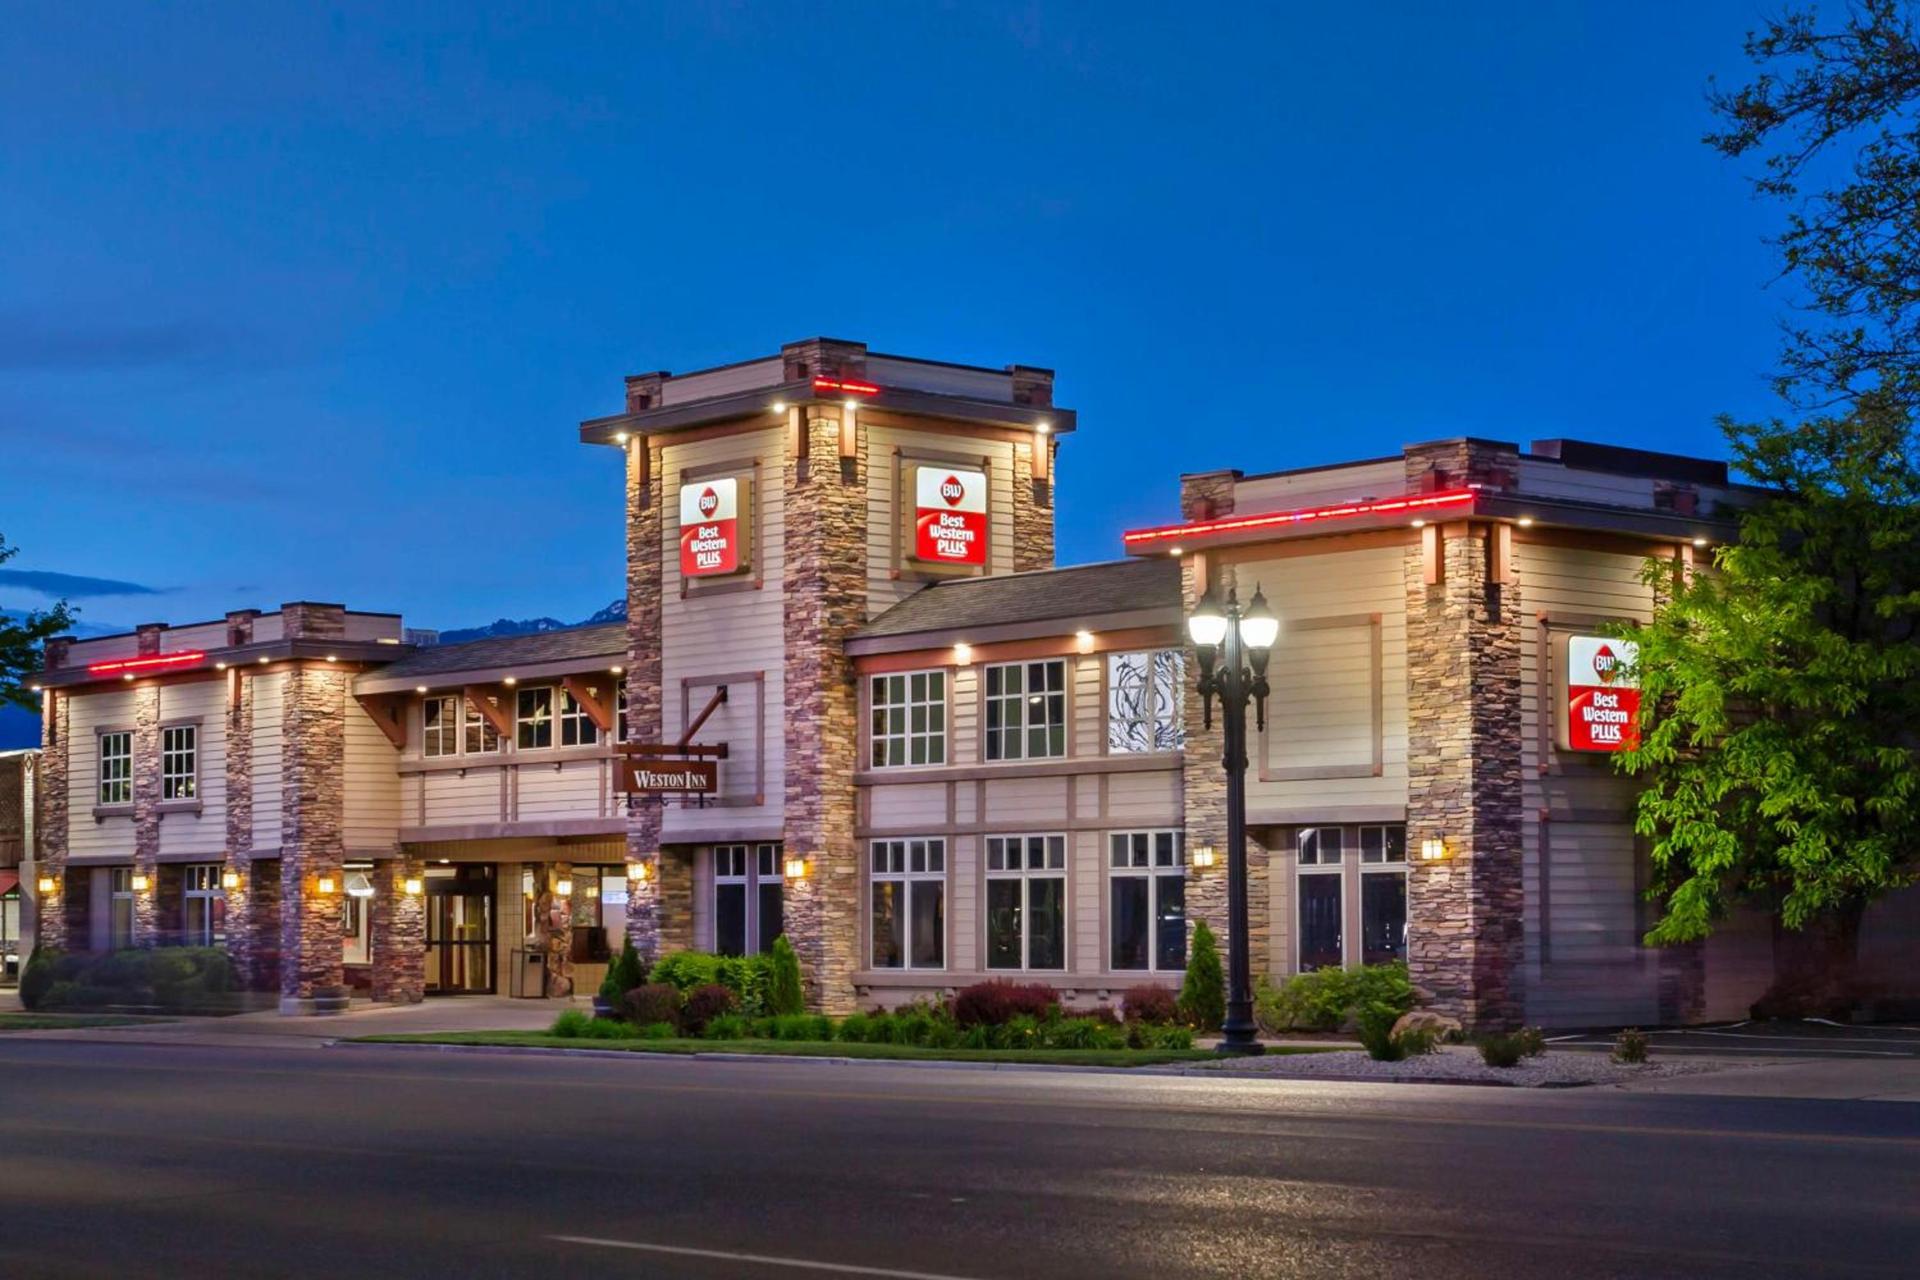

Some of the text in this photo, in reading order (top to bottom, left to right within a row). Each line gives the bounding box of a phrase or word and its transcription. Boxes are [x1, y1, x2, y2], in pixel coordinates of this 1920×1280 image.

[943, 483, 961, 497] BW
[940, 513, 965, 527] Best
[699, 526, 718, 539] Best
[929, 524, 974, 541] Western
[691, 538, 727, 552] Western
[937, 540, 967, 554] PLUS
[697, 551, 721, 566] PLUS
[1596, 656, 1614, 670] BW
[1594, 692, 1618, 707] Best
[1583, 706, 1628, 723] Western
